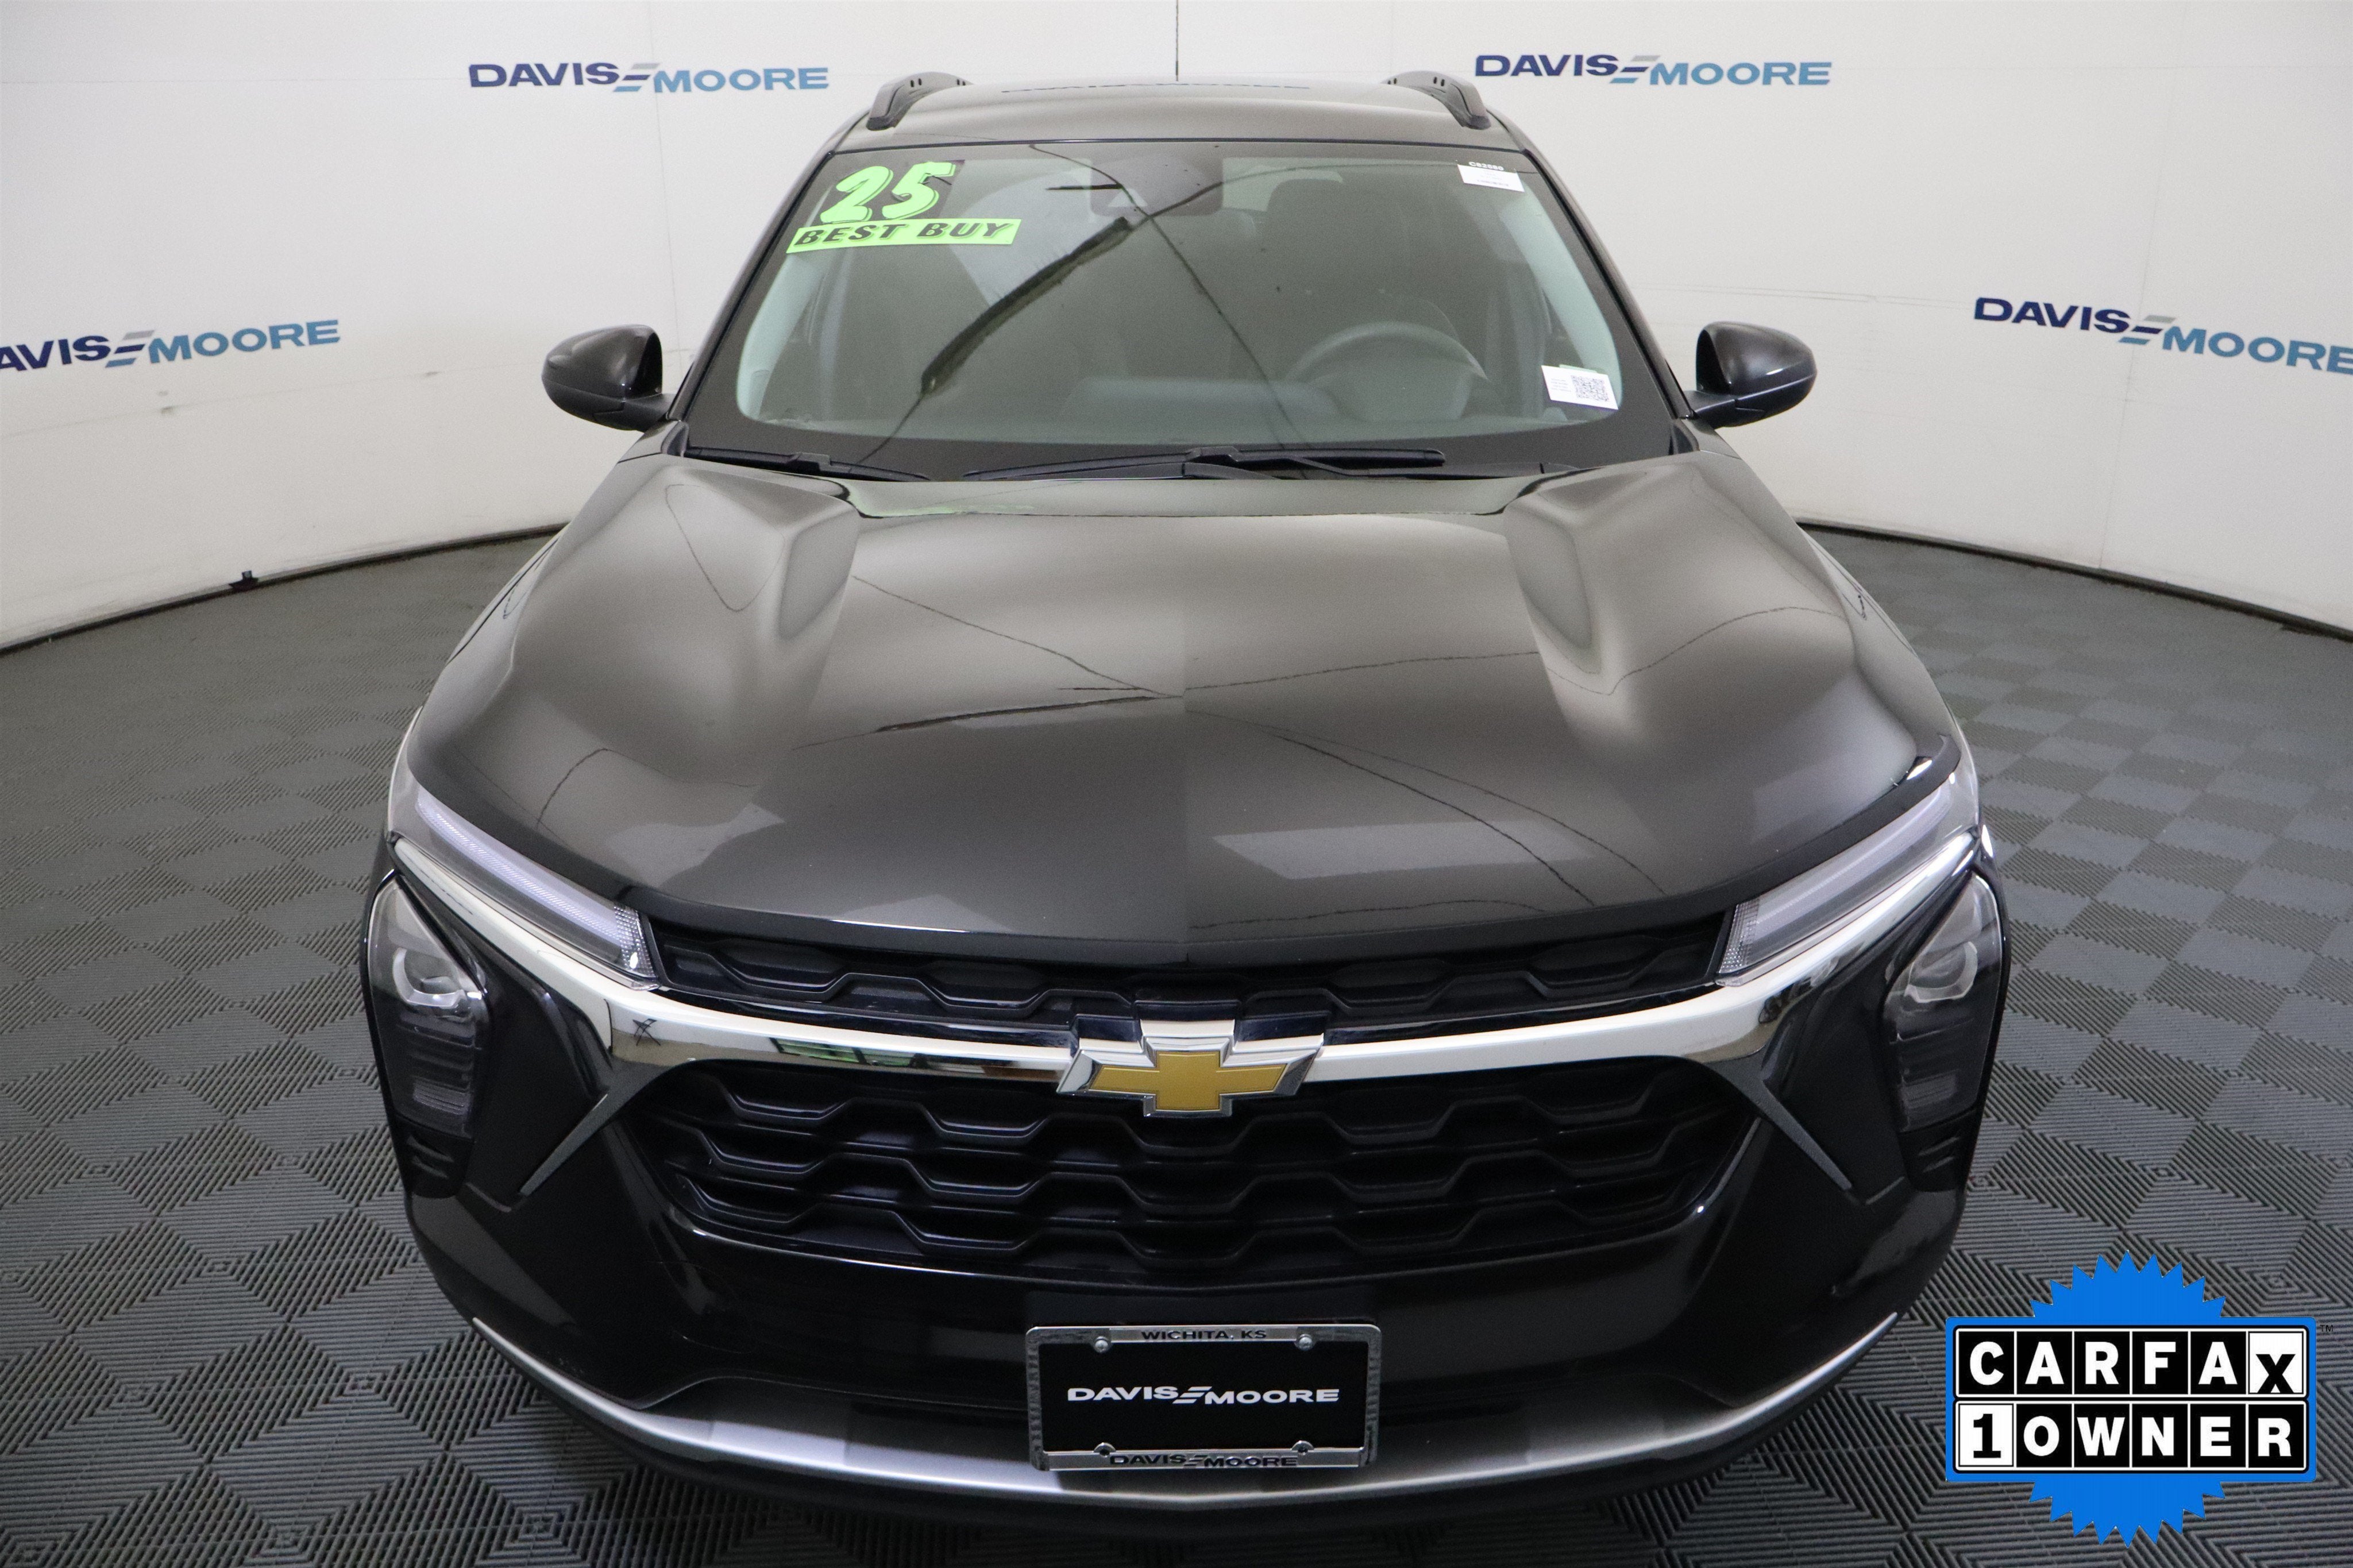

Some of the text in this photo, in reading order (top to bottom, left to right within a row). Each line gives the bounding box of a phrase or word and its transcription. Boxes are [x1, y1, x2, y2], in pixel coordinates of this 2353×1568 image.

[468, 62, 829, 93] DAVIS MOORE
[1474, 54, 1832, 86] DAVIS MOORE
[820, 161, 956, 223] 25
[793, 222, 1015, 247] BEST BUY
[148, 319, 341, 365] MOORE
[1973, 296, 2353, 376] DAVIS MOORE
[1241, 1330, 1267, 1339] KS
[1067, 1386, 1340, 1404] DAVIS MOORE
[1110, 1454, 1297, 1467] DAVIS MOORE
